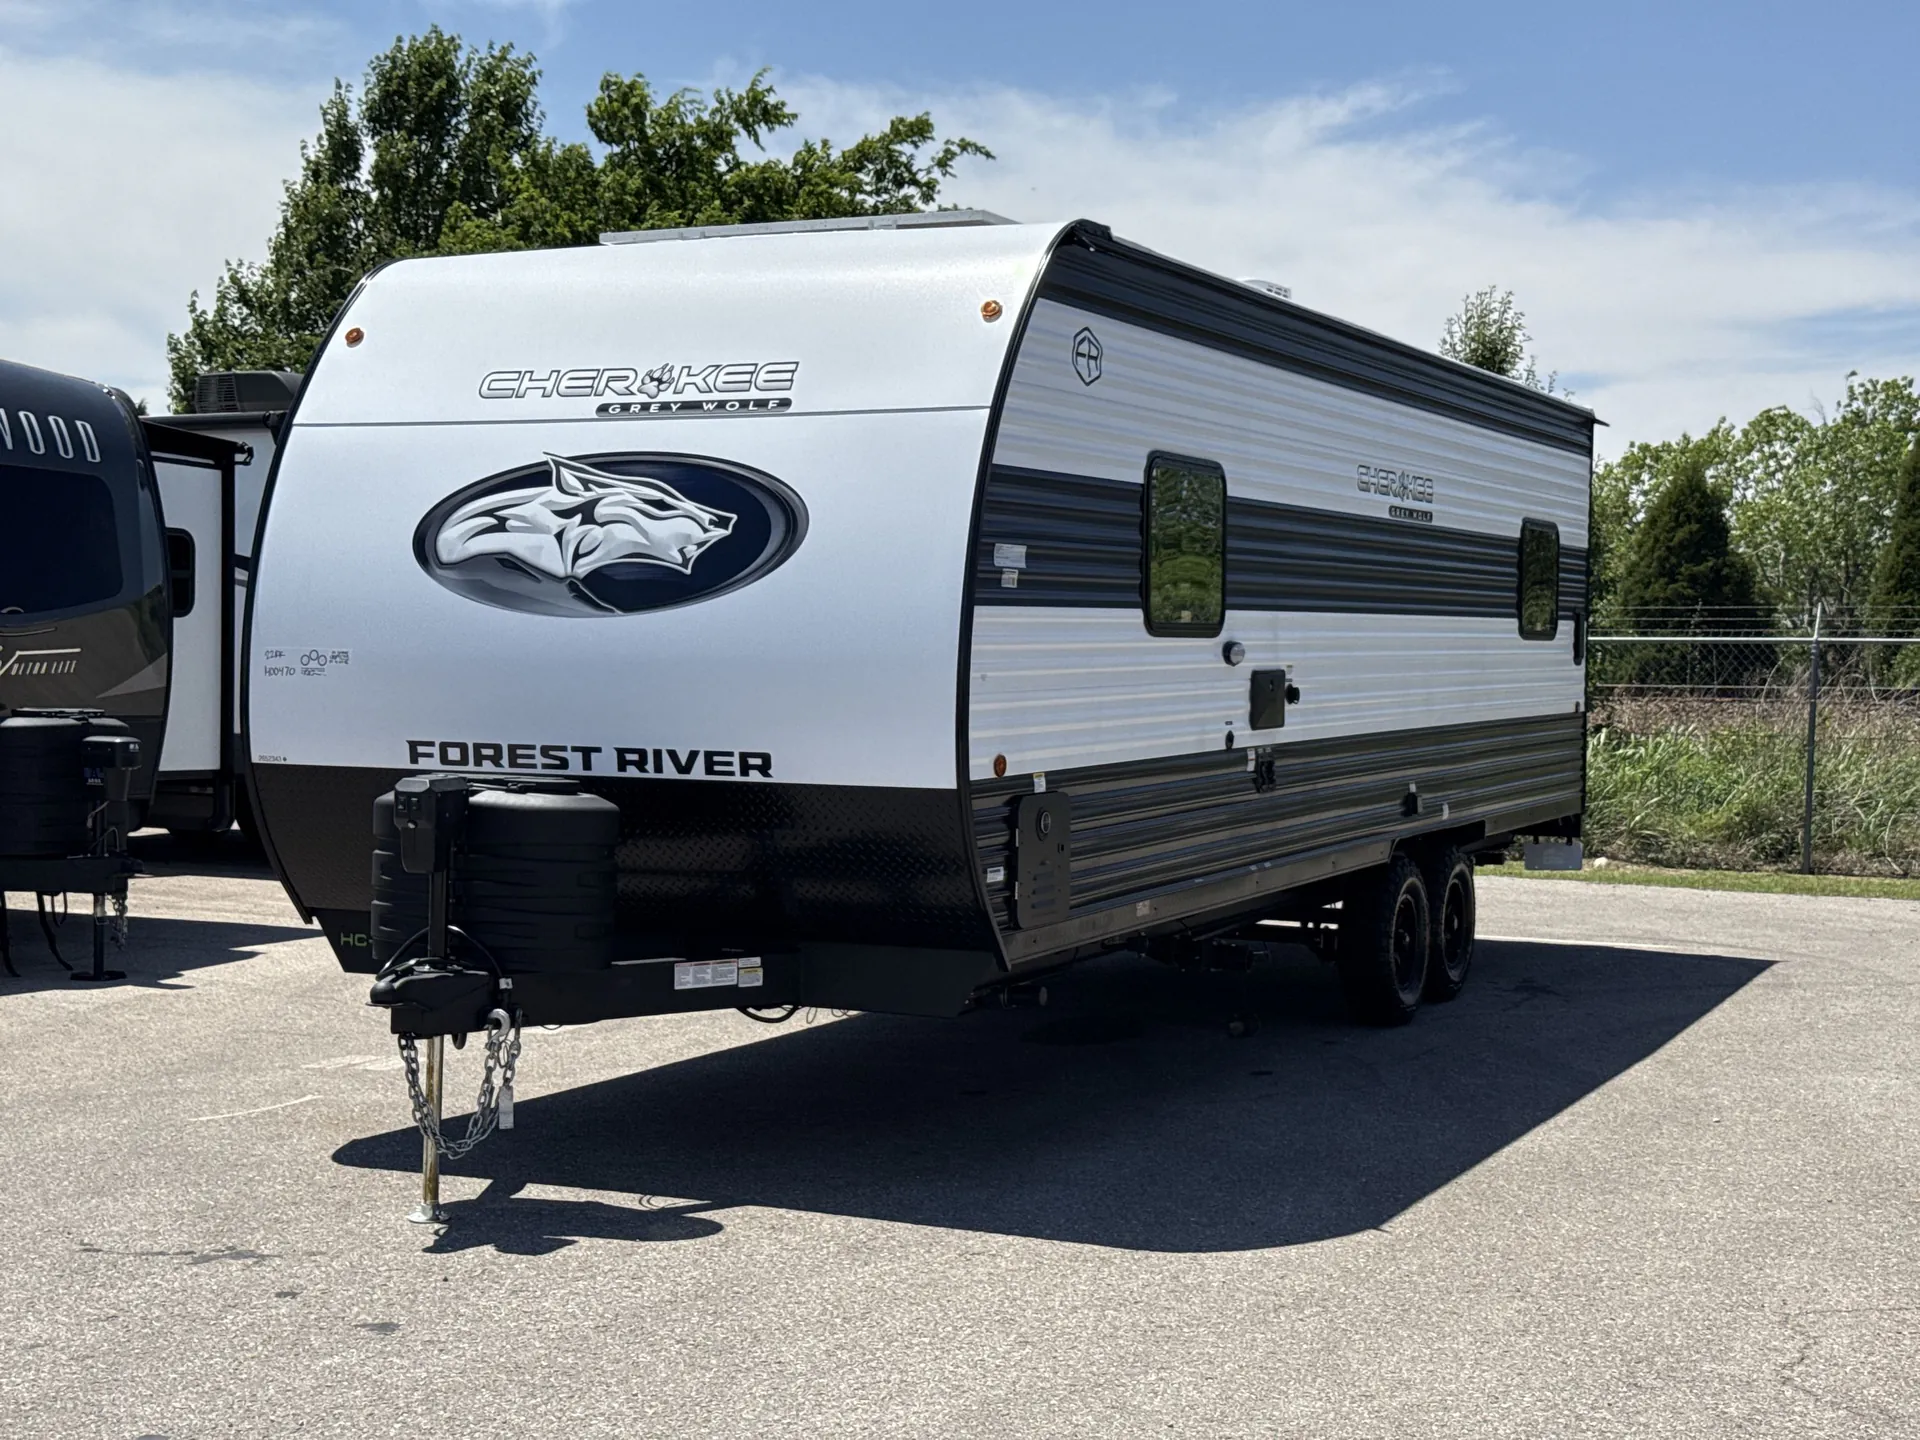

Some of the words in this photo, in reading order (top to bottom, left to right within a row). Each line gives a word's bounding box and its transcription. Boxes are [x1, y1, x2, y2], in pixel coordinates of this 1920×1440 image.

[608, 401, 681, 415] GREY
[702, 399, 781, 412] WOLF
[11, 661, 48, 676] ULTRA
[51, 660, 77, 674] LITE
[405, 740, 603, 771] FOREST
[613, 747, 774, 778] RIVER
